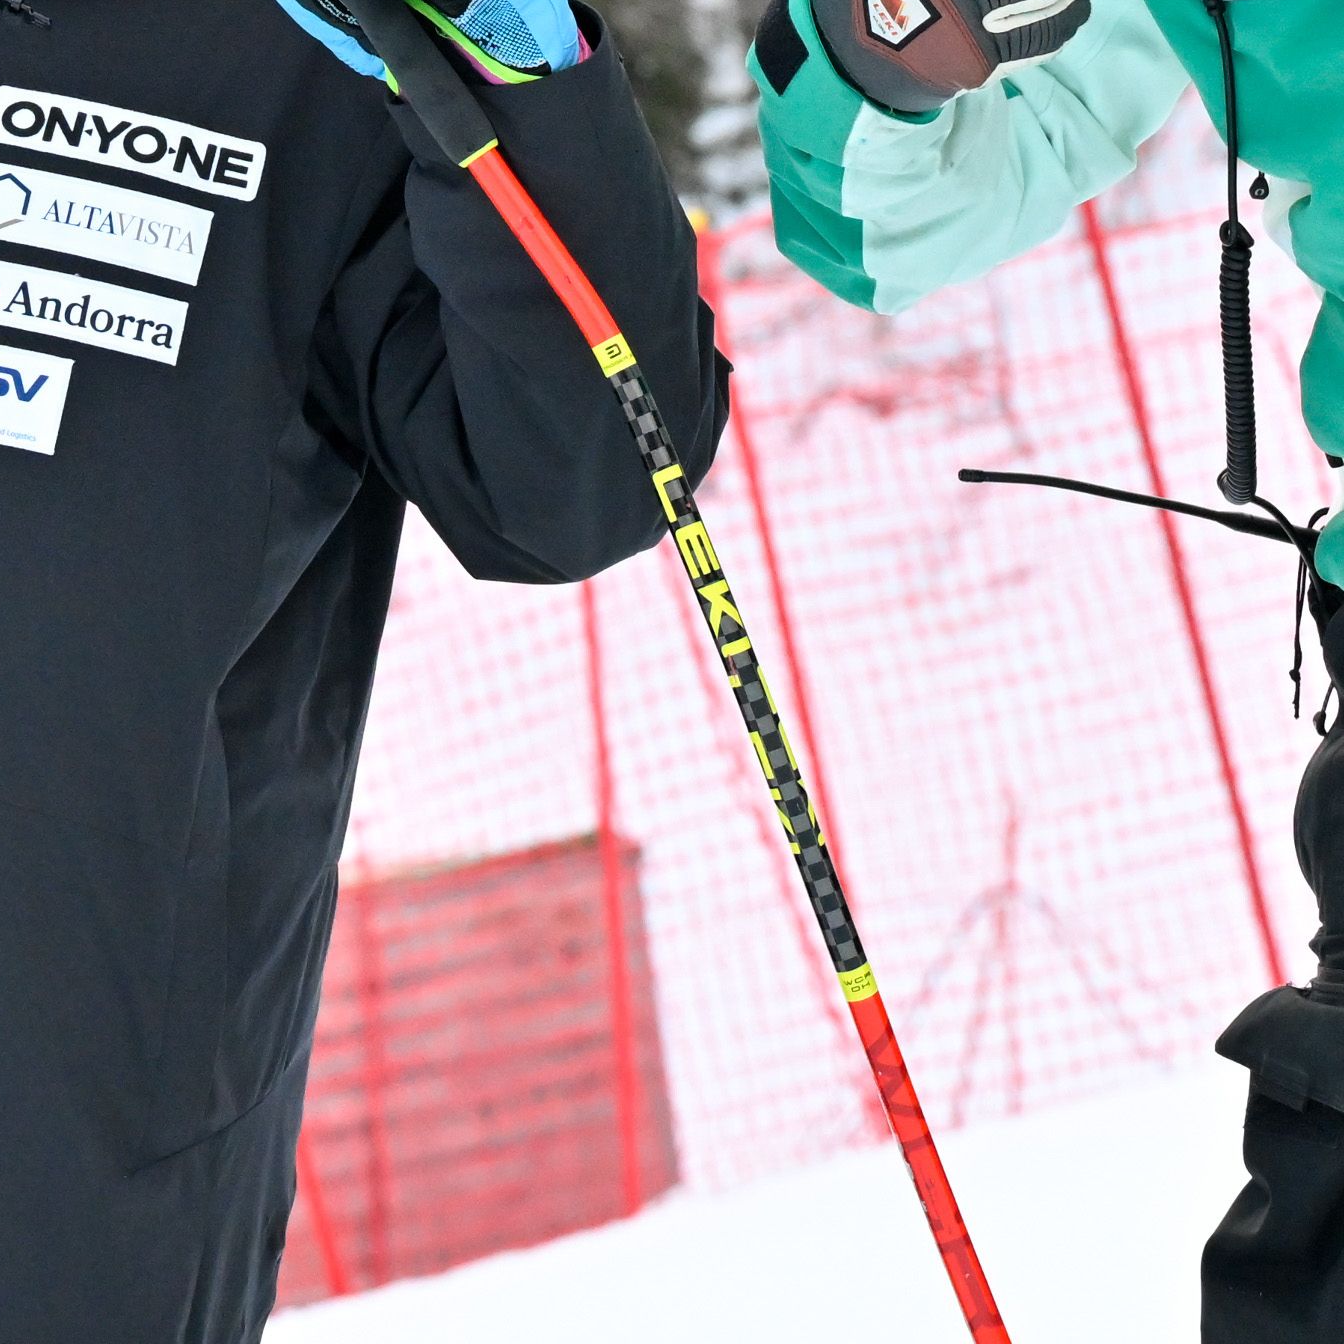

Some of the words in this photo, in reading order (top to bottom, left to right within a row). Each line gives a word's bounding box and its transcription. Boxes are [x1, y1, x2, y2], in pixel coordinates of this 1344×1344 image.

[41, 199, 195, 255] ALTAVISTA
[2, 280, 174, 349] Andorra
[652, 463, 752, 658] LEKI
